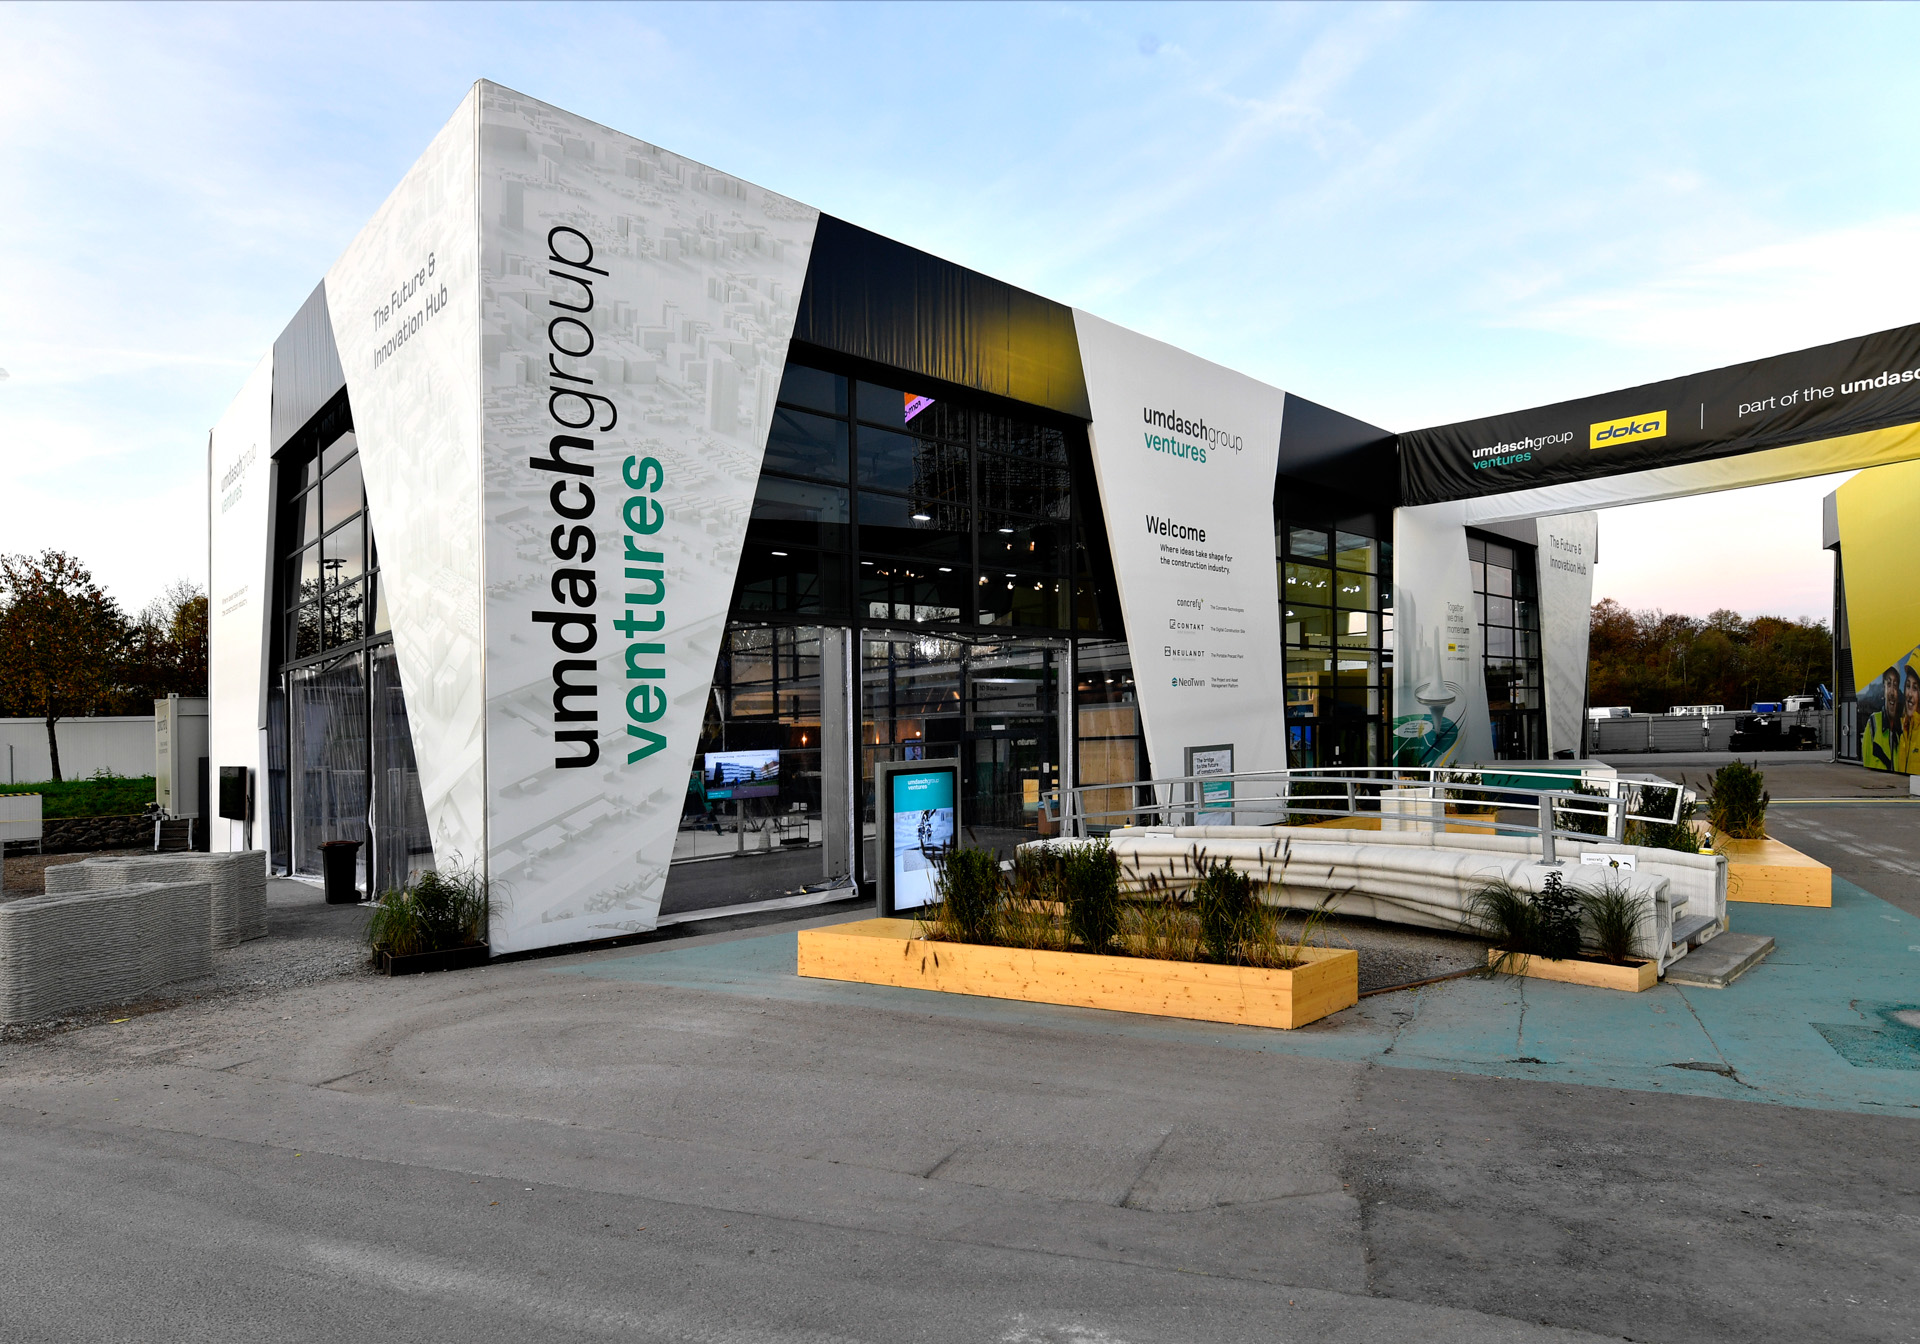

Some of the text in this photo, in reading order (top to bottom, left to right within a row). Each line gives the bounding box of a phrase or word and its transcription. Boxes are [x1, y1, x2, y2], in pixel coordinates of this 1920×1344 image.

[373, 252, 435, 332] The Future &
[374, 283, 448, 370] Innovation Hub
[1738, 396, 1776, 417] part
[1780, 390, 1798, 407] of
[1803, 386, 1834, 402] the
[1143, 407, 1243, 455] umdaschgroup
[1596, 420, 1660, 442] doka
[1144, 432, 1207, 463] ventures
[1472, 431, 1573, 459] umdaschgroup
[1473, 452, 1531, 470] ventures
[530, 225, 617, 769] umdaschgroup
[1145, 514, 1206, 542] Welcome
[1160, 543, 1233, 562] Where ideas take shape for
[1550, 534, 1559, 548] The
[1561, 538, 1577, 554] Future
[1160, 556, 1170, 565] the
[1171, 559, 1207, 570] construction
[1550, 555, 1586, 576] Innovation Hub
[614, 454, 667, 765] ventures
[1176, 598, 1201, 611] concrefy
[1177, 622, 1204, 631] CONTAKT
[1172, 649, 1205, 657] NEULANDT
[1178, 677, 1205, 686] NeoTwin
